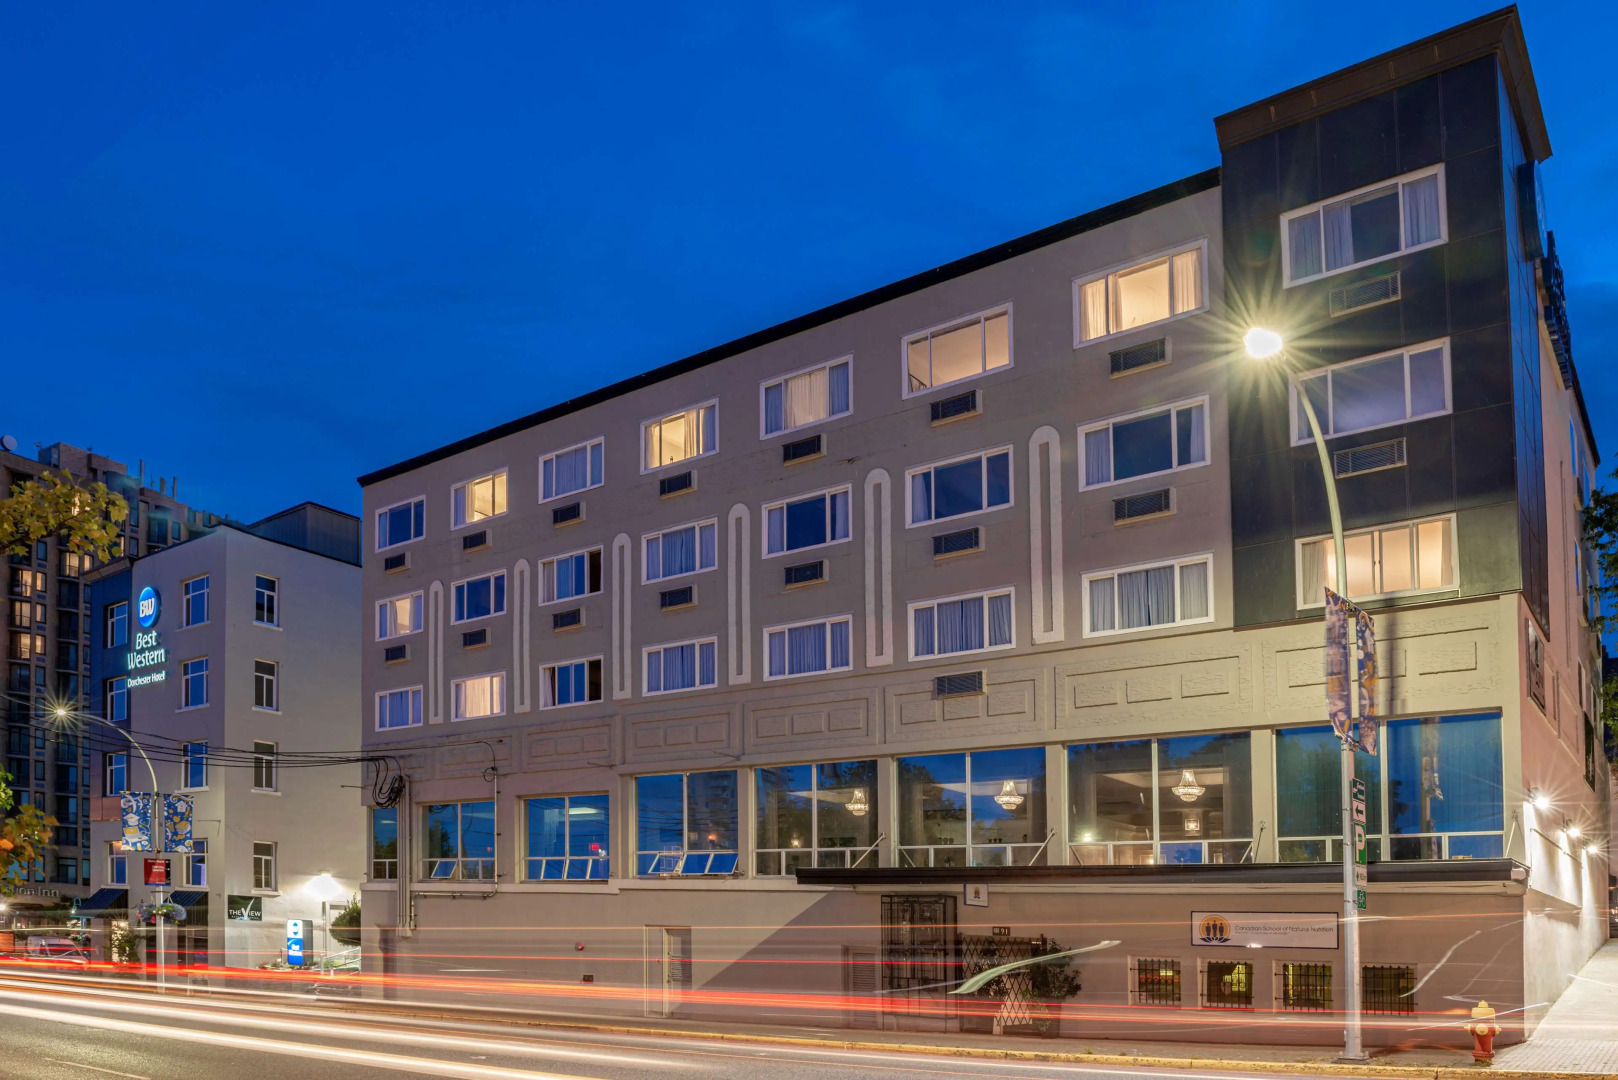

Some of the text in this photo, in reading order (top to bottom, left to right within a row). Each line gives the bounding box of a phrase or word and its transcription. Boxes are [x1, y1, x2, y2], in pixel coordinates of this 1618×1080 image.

[140, 598, 155, 617] BW
[136, 631, 157, 650] Best
[127, 648, 166, 670] Western
[127, 670, 165, 688] Dorchester Hotel
[38, 886, 60, 897] Inn
